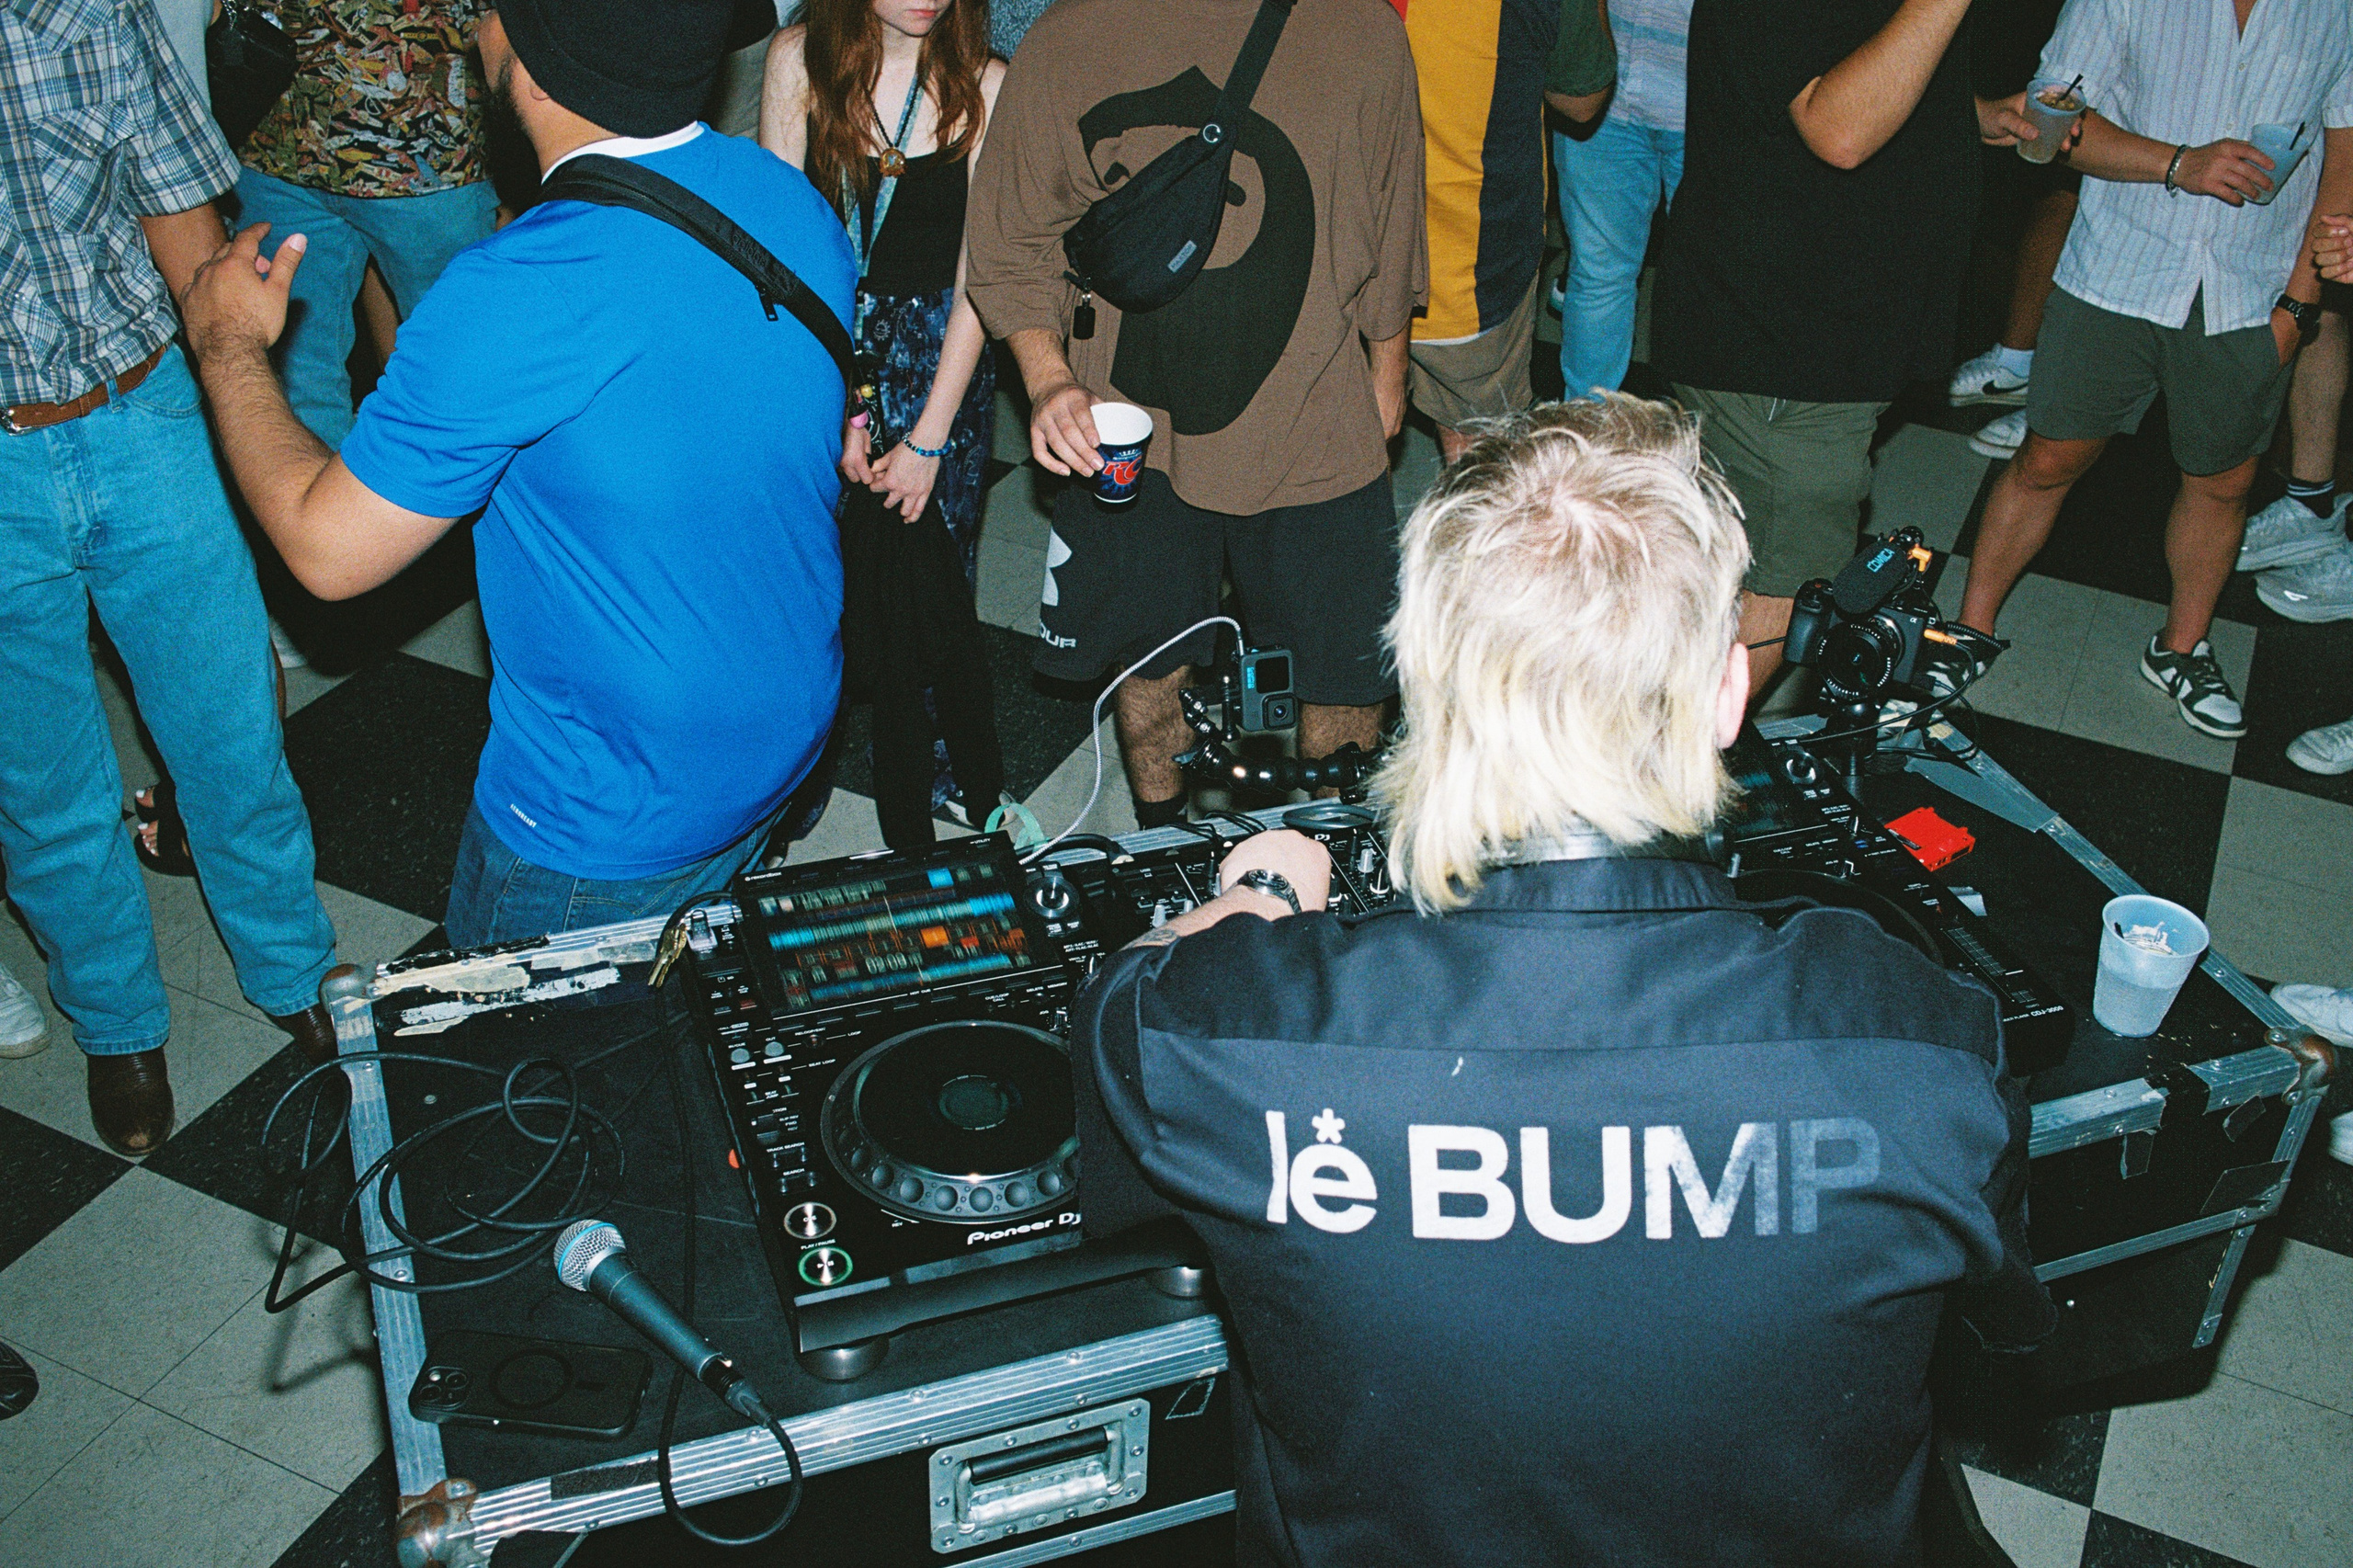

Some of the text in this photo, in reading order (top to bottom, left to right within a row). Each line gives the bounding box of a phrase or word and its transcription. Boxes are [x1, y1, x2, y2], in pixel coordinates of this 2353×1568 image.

[1103, 456, 1142, 484] RC
[1314, 833, 1331, 841] DJ
[750, 872, 781, 881] rekordbox
[2030, 1006, 2063, 1017] CDJ-3000
[1408, 1116, 1881, 1244] BUMP
[967, 1220, 1054, 1245] Pioneer
